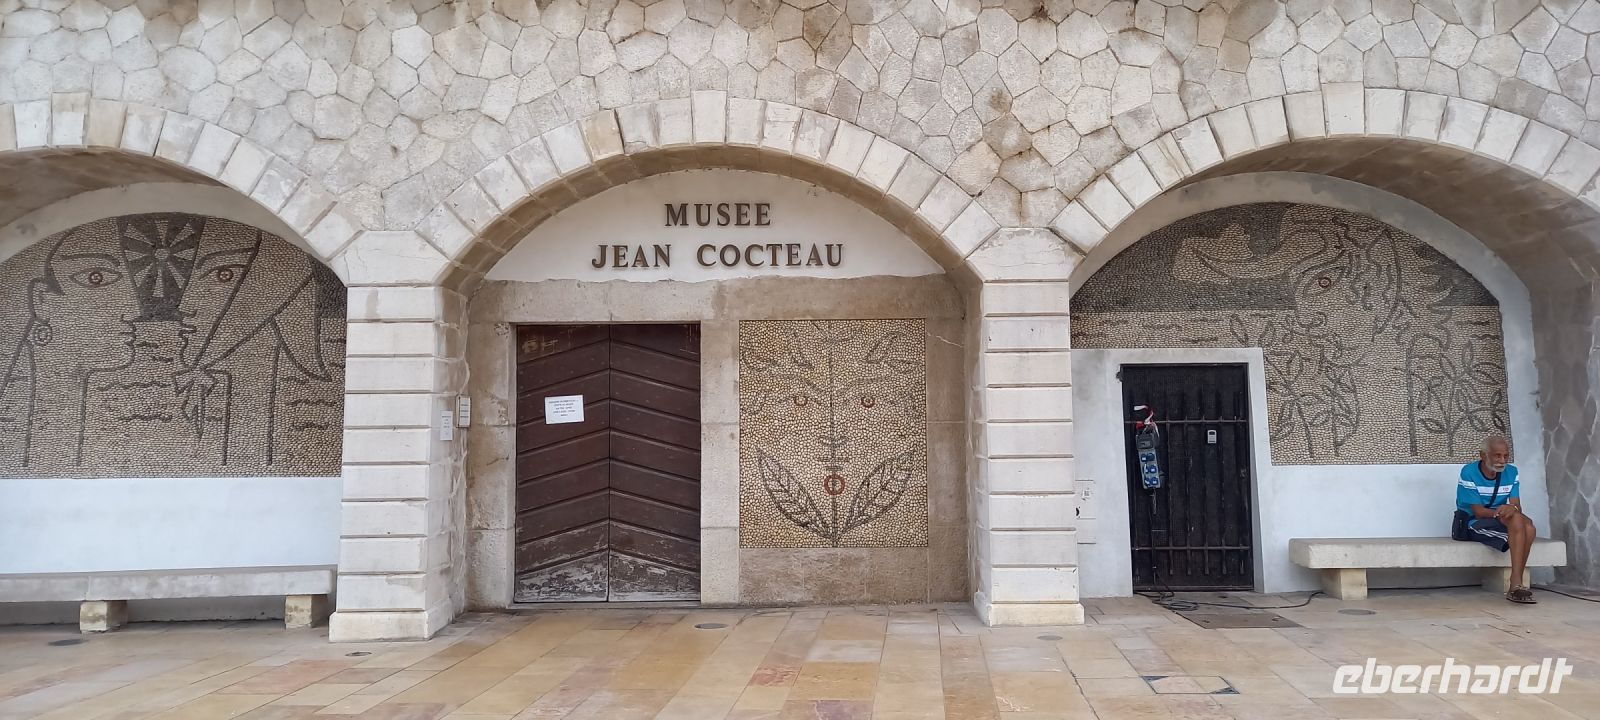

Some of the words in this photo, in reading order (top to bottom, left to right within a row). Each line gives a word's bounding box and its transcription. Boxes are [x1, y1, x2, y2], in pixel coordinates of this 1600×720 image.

[664, 202, 771, 227] MUSEE
[591, 244, 671, 268] JEAN
[696, 243, 843, 267] COCTEAU
